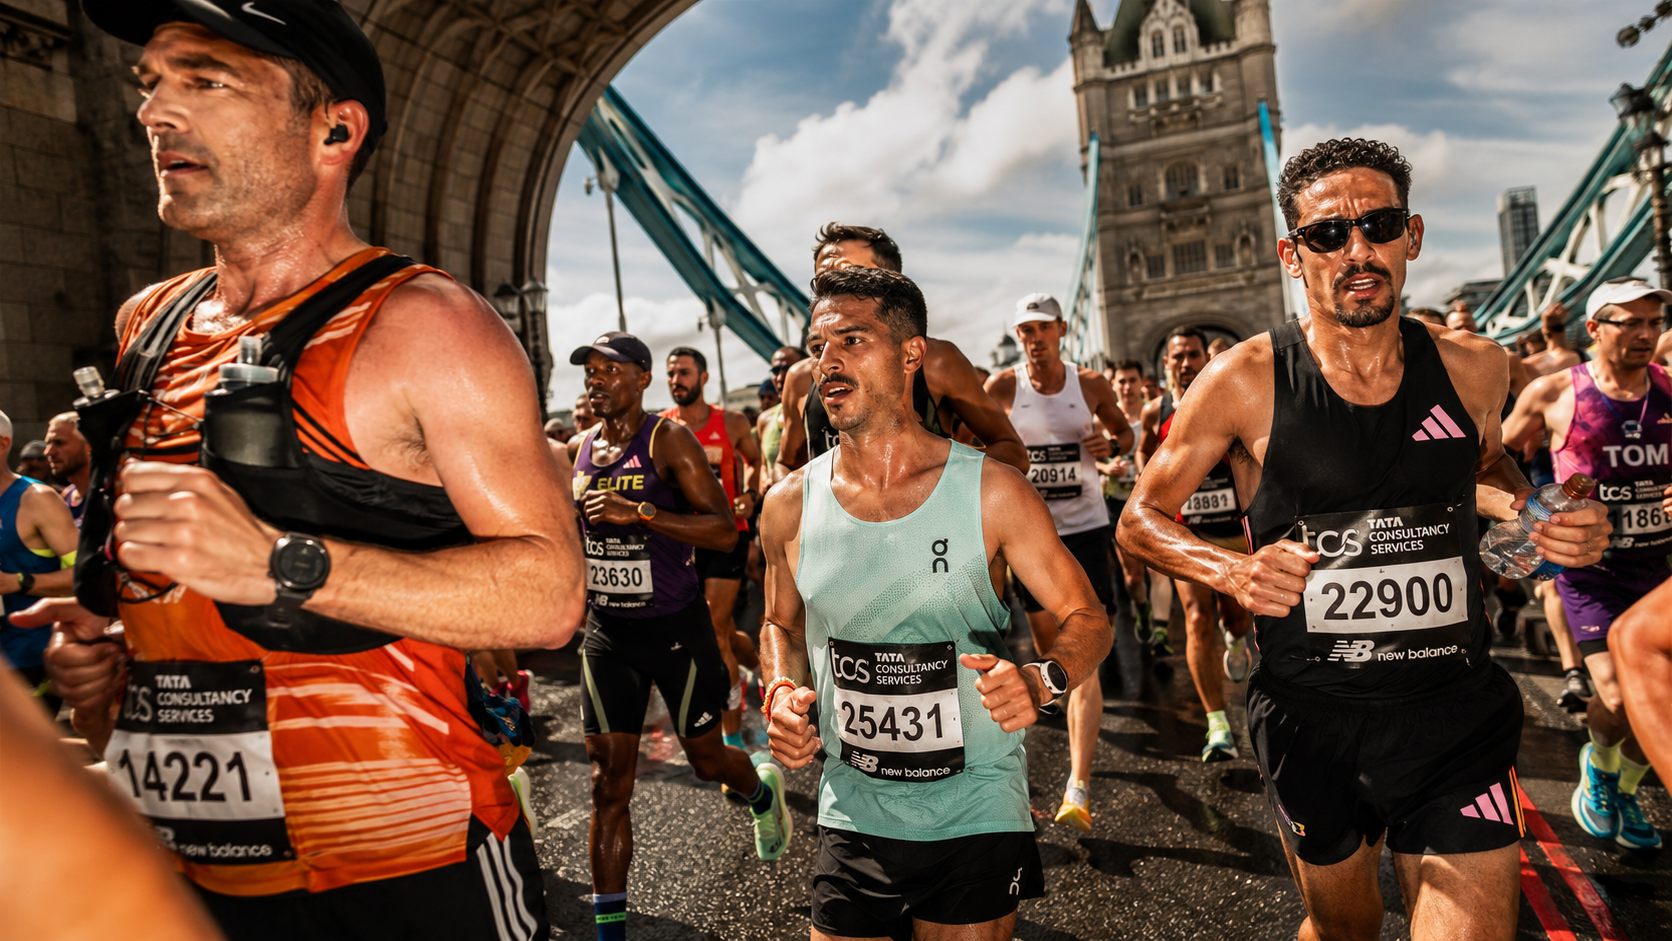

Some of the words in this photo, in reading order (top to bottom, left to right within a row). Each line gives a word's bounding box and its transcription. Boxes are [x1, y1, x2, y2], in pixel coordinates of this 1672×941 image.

[1602, 443, 1669, 468] TOM
[597, 475, 644, 491] ELITE
[1031, 466, 1076, 483] 20914
[1599, 483, 1632, 501] tcs
[1367, 516, 1403, 529] TATA
[1301, 524, 1363, 558] tcs
[1368, 523, 1450, 542] CONSULTANCY
[586, 537, 604, 556] tcs
[1370, 539, 1424, 555] SERVICES
[591, 566, 642, 587] 23630
[1321, 572, 1453, 621] 22900
[875, 652, 905, 662] TATA
[1377, 651, 1405, 661] new
[1408, 645, 1458, 660] balance
[831, 647, 870, 684] tcs
[875, 660, 948, 674] CONSULTANCY
[155, 674, 191, 689] TATA
[876, 674, 922, 685] SERVICES
[156, 689, 253, 706] CONSULTANCY
[157, 708, 215, 723] SERVICES
[841, 701, 943, 741] 25431
[118, 749, 252, 802] 14221
[881, 767, 902, 776] new
[905, 767, 950, 778] balance
[207, 842, 273, 857] balance
